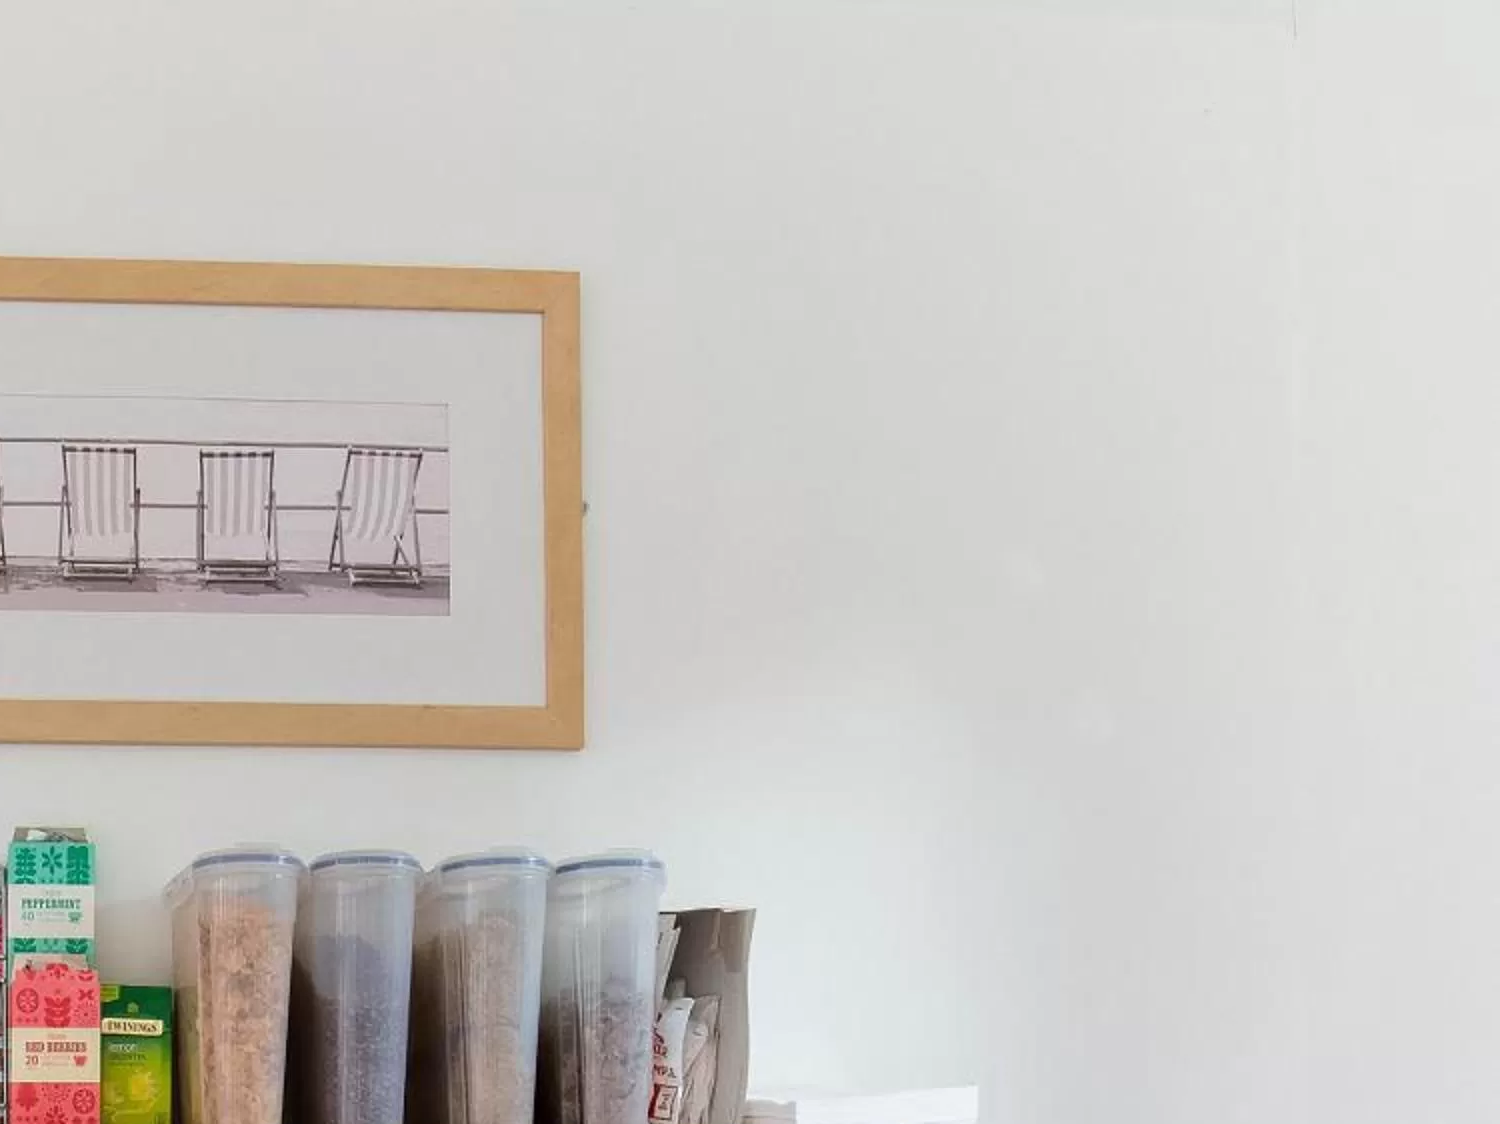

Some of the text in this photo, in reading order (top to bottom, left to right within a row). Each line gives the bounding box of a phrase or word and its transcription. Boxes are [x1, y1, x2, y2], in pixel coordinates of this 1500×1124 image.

[21, 898, 82, 909] PEPPERMINT
[46, 1041, 88, 1053] BERRIES
[25, 1055, 40, 1066] 20
